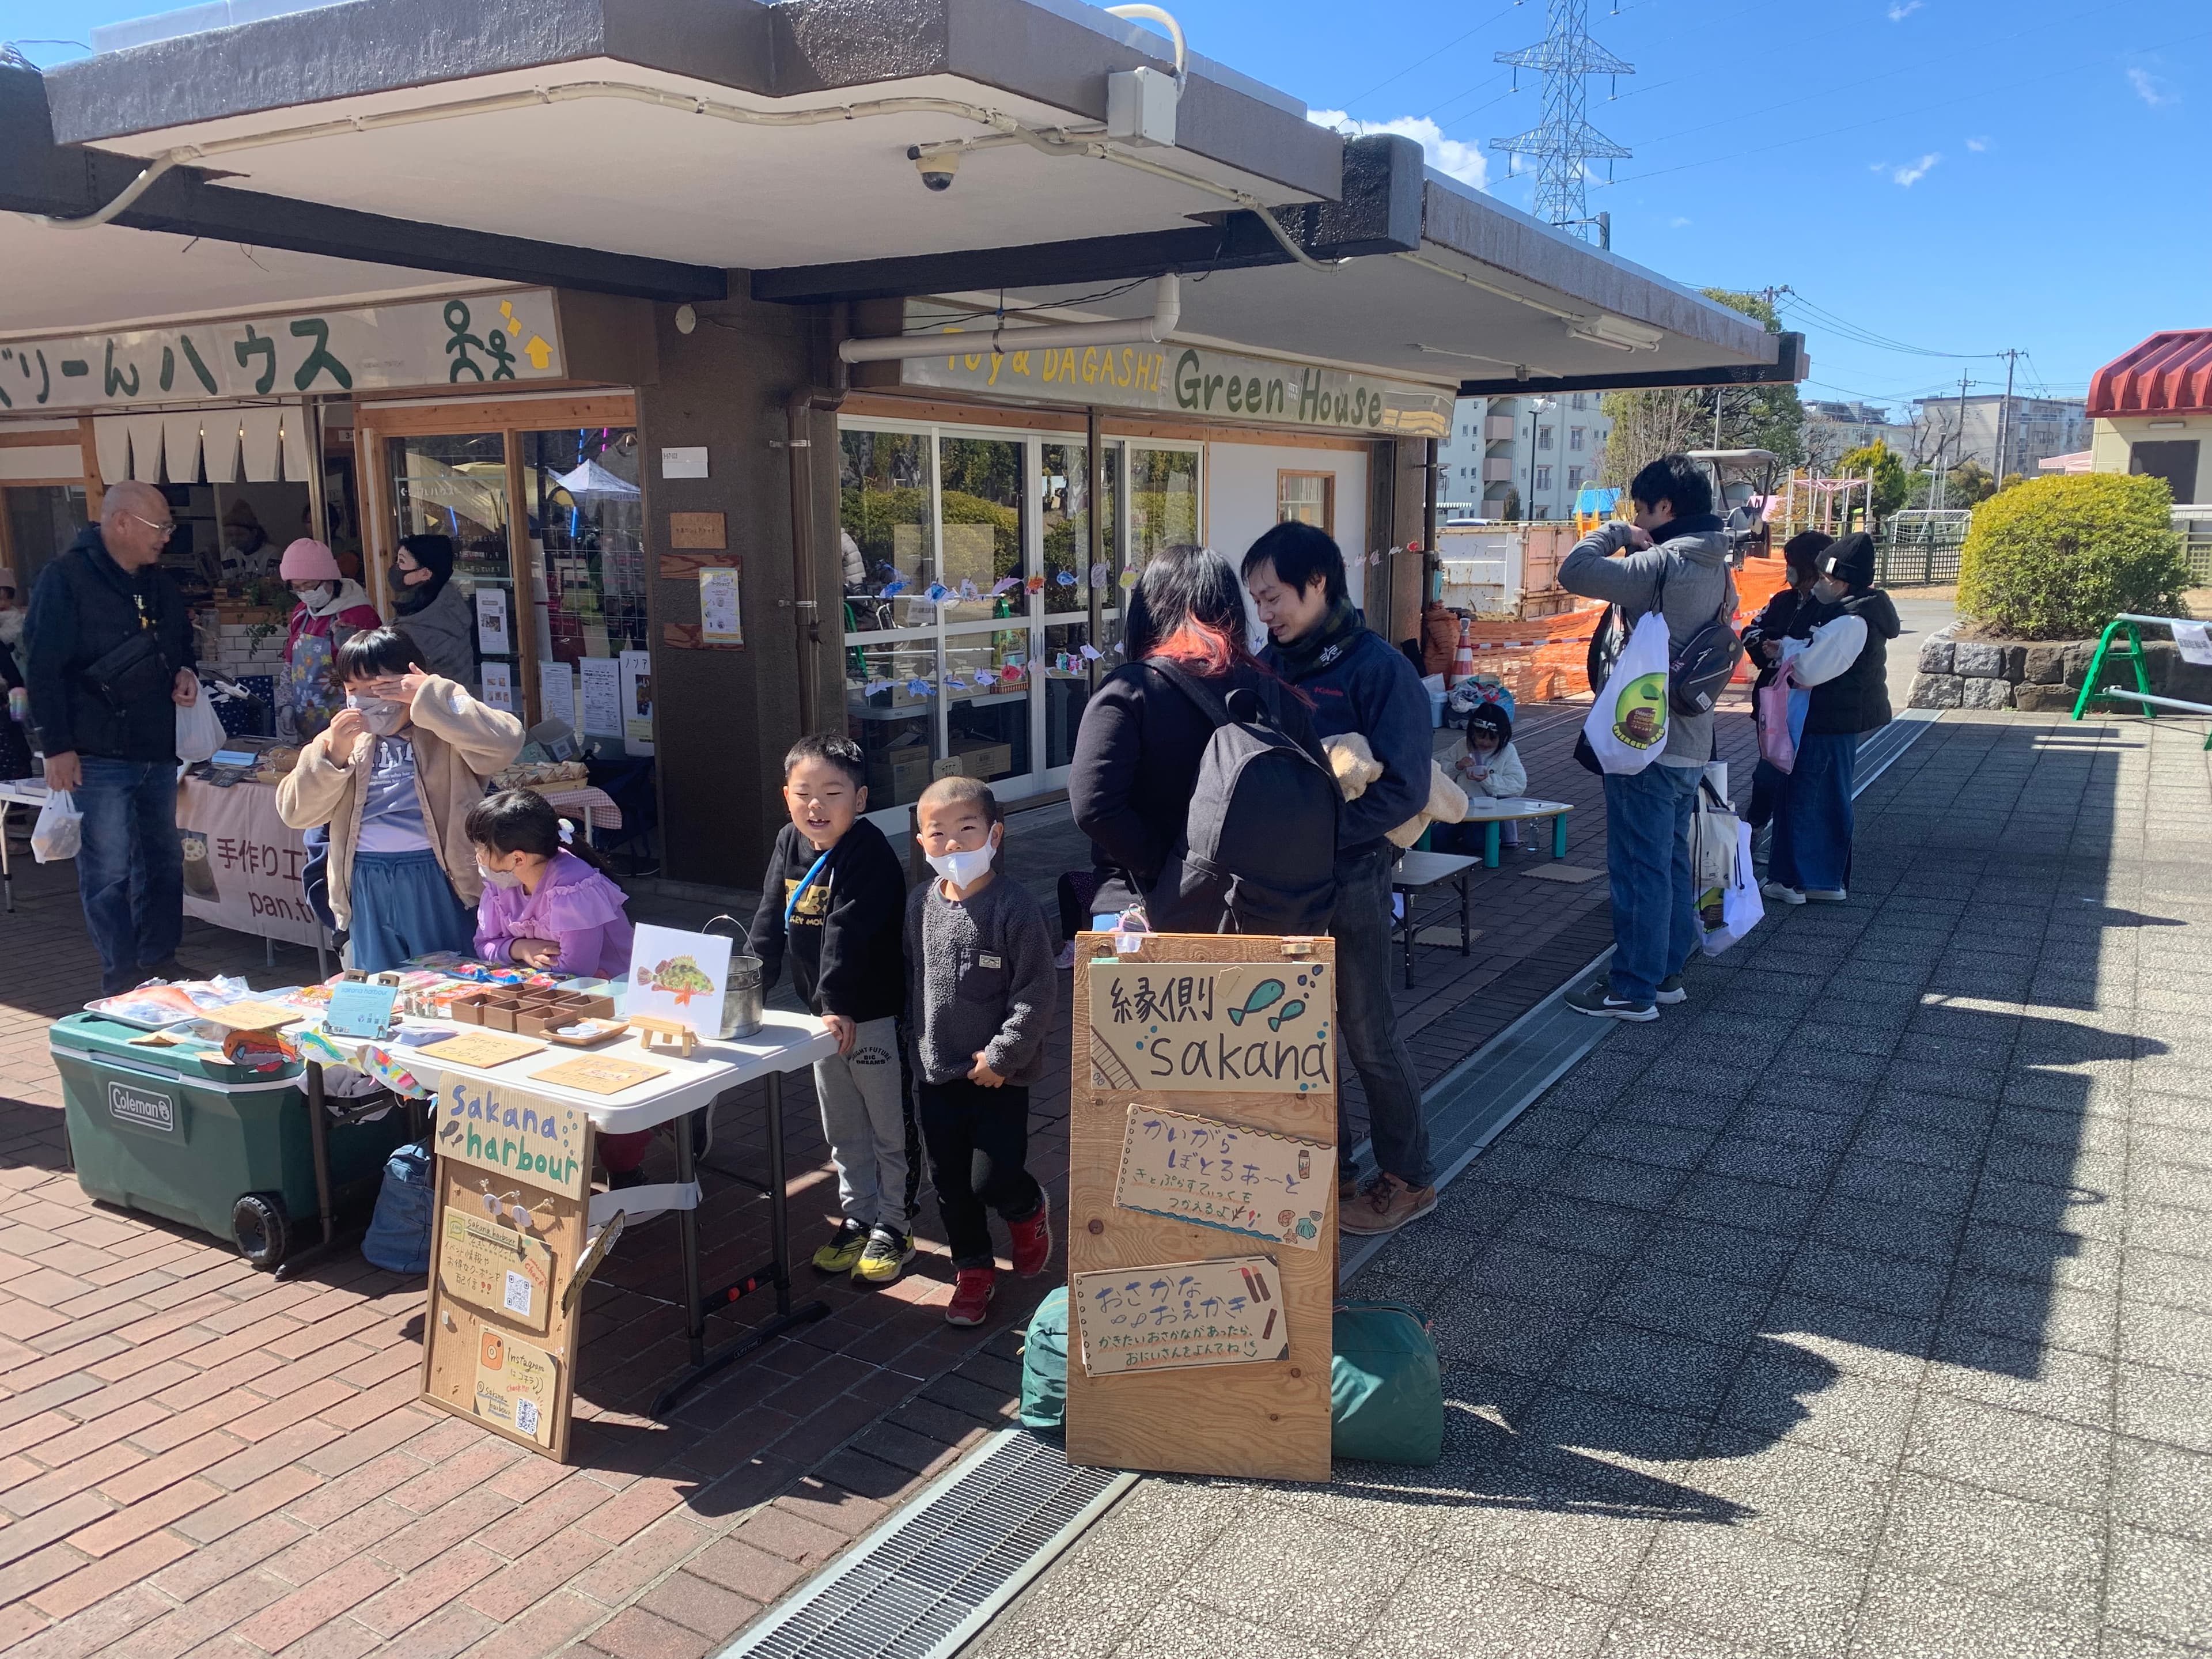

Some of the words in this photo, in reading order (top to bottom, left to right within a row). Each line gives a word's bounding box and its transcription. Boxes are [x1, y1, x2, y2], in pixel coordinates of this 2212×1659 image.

[1175, 349, 1285, 413] Green
[1298, 368, 1382, 428] House
[217, 838, 308, 881] 手作り工
[1111, 976, 1214, 1024] 縁側
[869, 1046, 892, 1062] FUTURE
[112, 1088, 159, 1119] Coleman
[450, 1085, 558, 1141] Sakana
[467, 1121, 579, 1185] harbour
[1142, 1119, 1238, 1154] かいがら
[1169, 1197, 1230, 1218] つかえるよ
[446, 1256, 501, 1282] お得なクーポンを
[1095, 1275, 1202, 1313] おさかな
[1149, 1296, 1247, 1326] おえかき
[507, 1347, 545, 1373] Instagram
[488, 1400, 511, 1415] harbour
